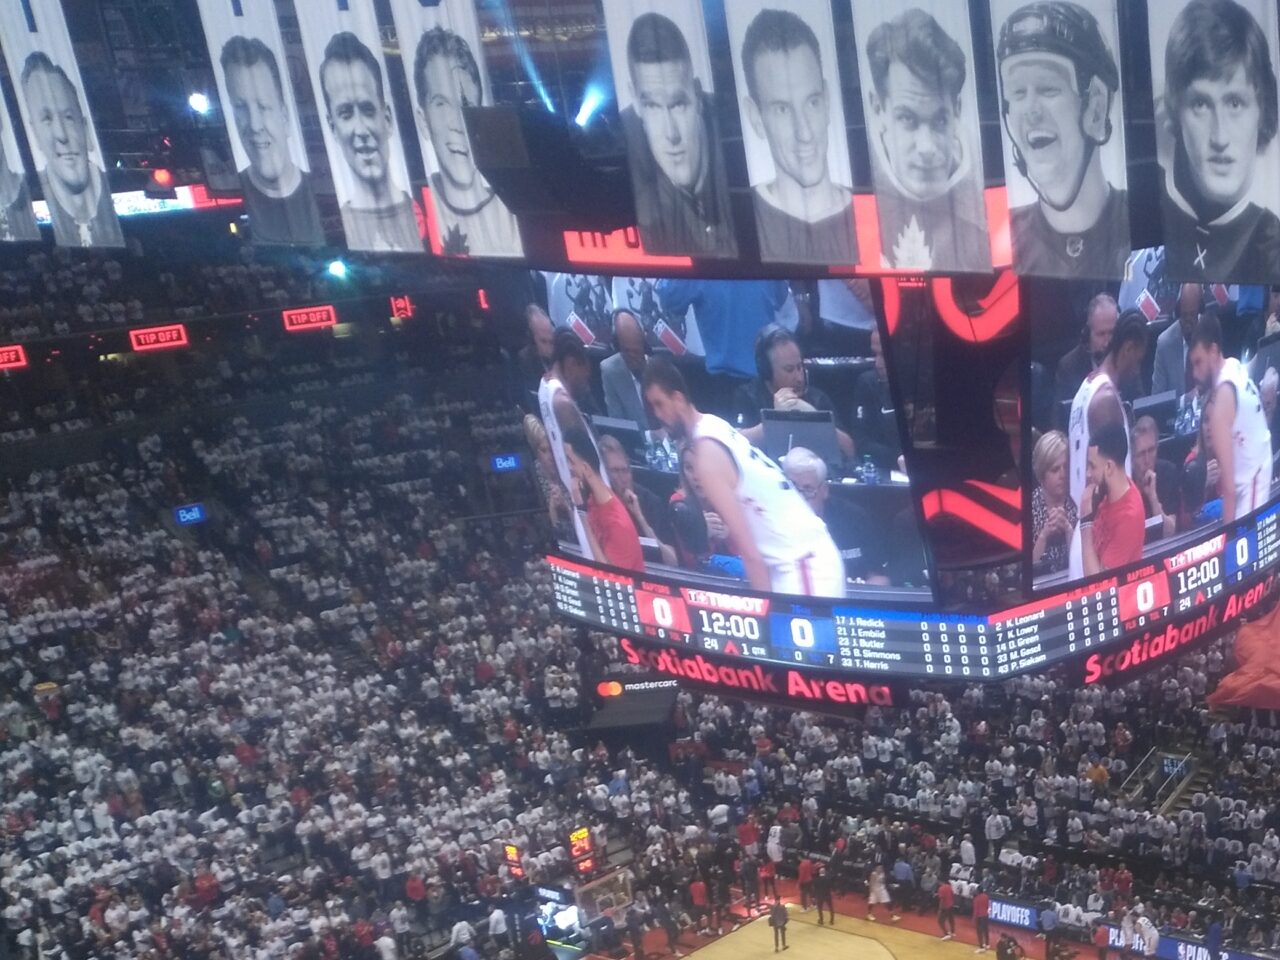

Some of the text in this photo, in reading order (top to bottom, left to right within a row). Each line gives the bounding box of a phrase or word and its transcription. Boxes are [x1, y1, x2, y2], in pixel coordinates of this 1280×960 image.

[291, 311, 328, 324] TIP OFF
[138, 330, 179, 345] TIP OFF
[496, 455, 515, 469] Bell
[179, 508, 200, 521] Bell
[1236, 537, 1248, 566] 0
[1178, 557, 1219, 594] 12:00
[1014, 609, 1045, 626] Leonard
[1066, 601, 1072, 610] 0
[1082, 596, 1087, 605] 0
[1096, 591, 1101, 600] 0
[1110, 587, 1115, 595] 0
[1137, 581, 1154, 612] 0
[1179, 596, 1191, 611] 24
[1206, 587, 1212, 598] 1
[653, 597, 672, 627] 0
[997, 633, 1003, 641] 7
[1016, 624, 1039, 637] Lowry
[1067, 612, 1073, 620] 0
[1082, 607, 1088, 616] 0
[1097, 602, 1102, 611] 0
[1111, 597, 1116, 606] 0
[1138, 616, 1145, 626] 0
[658, 628, 665, 638] 0
[684, 634, 690, 643] 7
[699, 610, 760, 640] 12:00
[790, 618, 814, 647] 0
[835, 616, 845, 625] 17
[921, 622, 928, 630] 0
[940, 622, 946, 631] 0
[958, 624, 965, 632] 0
[978, 624, 985, 633] 0
[837, 627, 847, 636] 21
[922, 633, 929, 641] 0
[941, 634, 948, 642] 0
[959, 635, 966, 643] 0
[979, 636, 986, 644] 0
[1017, 635, 1040, 647] Green
[1068, 622, 1074, 631] 0
[1083, 617, 1089, 626] 0
[1098, 612, 1103, 621] 0
[1112, 608, 1117, 616] 0
[1084, 574, 1275, 684] Scotiabank Arena
[704, 637, 719, 650] 24
[741, 643, 749, 655] 1
[924, 643, 931, 652] 0
[942, 644, 949, 652] 0
[960, 645, 967, 654] 0
[980, 646, 987, 654] 0
[997, 654, 1008, 664] 33
[1069, 632, 1075, 641] 0
[1084, 627, 1090, 636] 0
[1099, 622, 1104, 631] 0
[1113, 618, 1118, 626] 0
[1019, 654, 1047, 668] Siakam
[1070, 643, 1075, 652] 0
[1085, 638, 1091, 646] 0
[1100, 633, 1105, 641] 0
[1113, 628, 1118, 636] 0
[794, 651, 834, 664] 0 7
[840, 647, 851, 656] 25
[863, 649, 901, 660] Simmons
[925, 654, 932, 662] 0
[944, 655, 951, 663] 0
[962, 656, 968, 664] 0
[982, 656, 988, 665] 0
[863, 659, 889, 670] Harris
[926, 664, 933, 673] 0
[945, 665, 952, 674] 0
[963, 666, 970, 675] 0
[983, 667, 990, 676] 0
[620, 638, 893, 706] Scotiabank Arena
[992, 901, 1031, 926] PLAYOFFS
